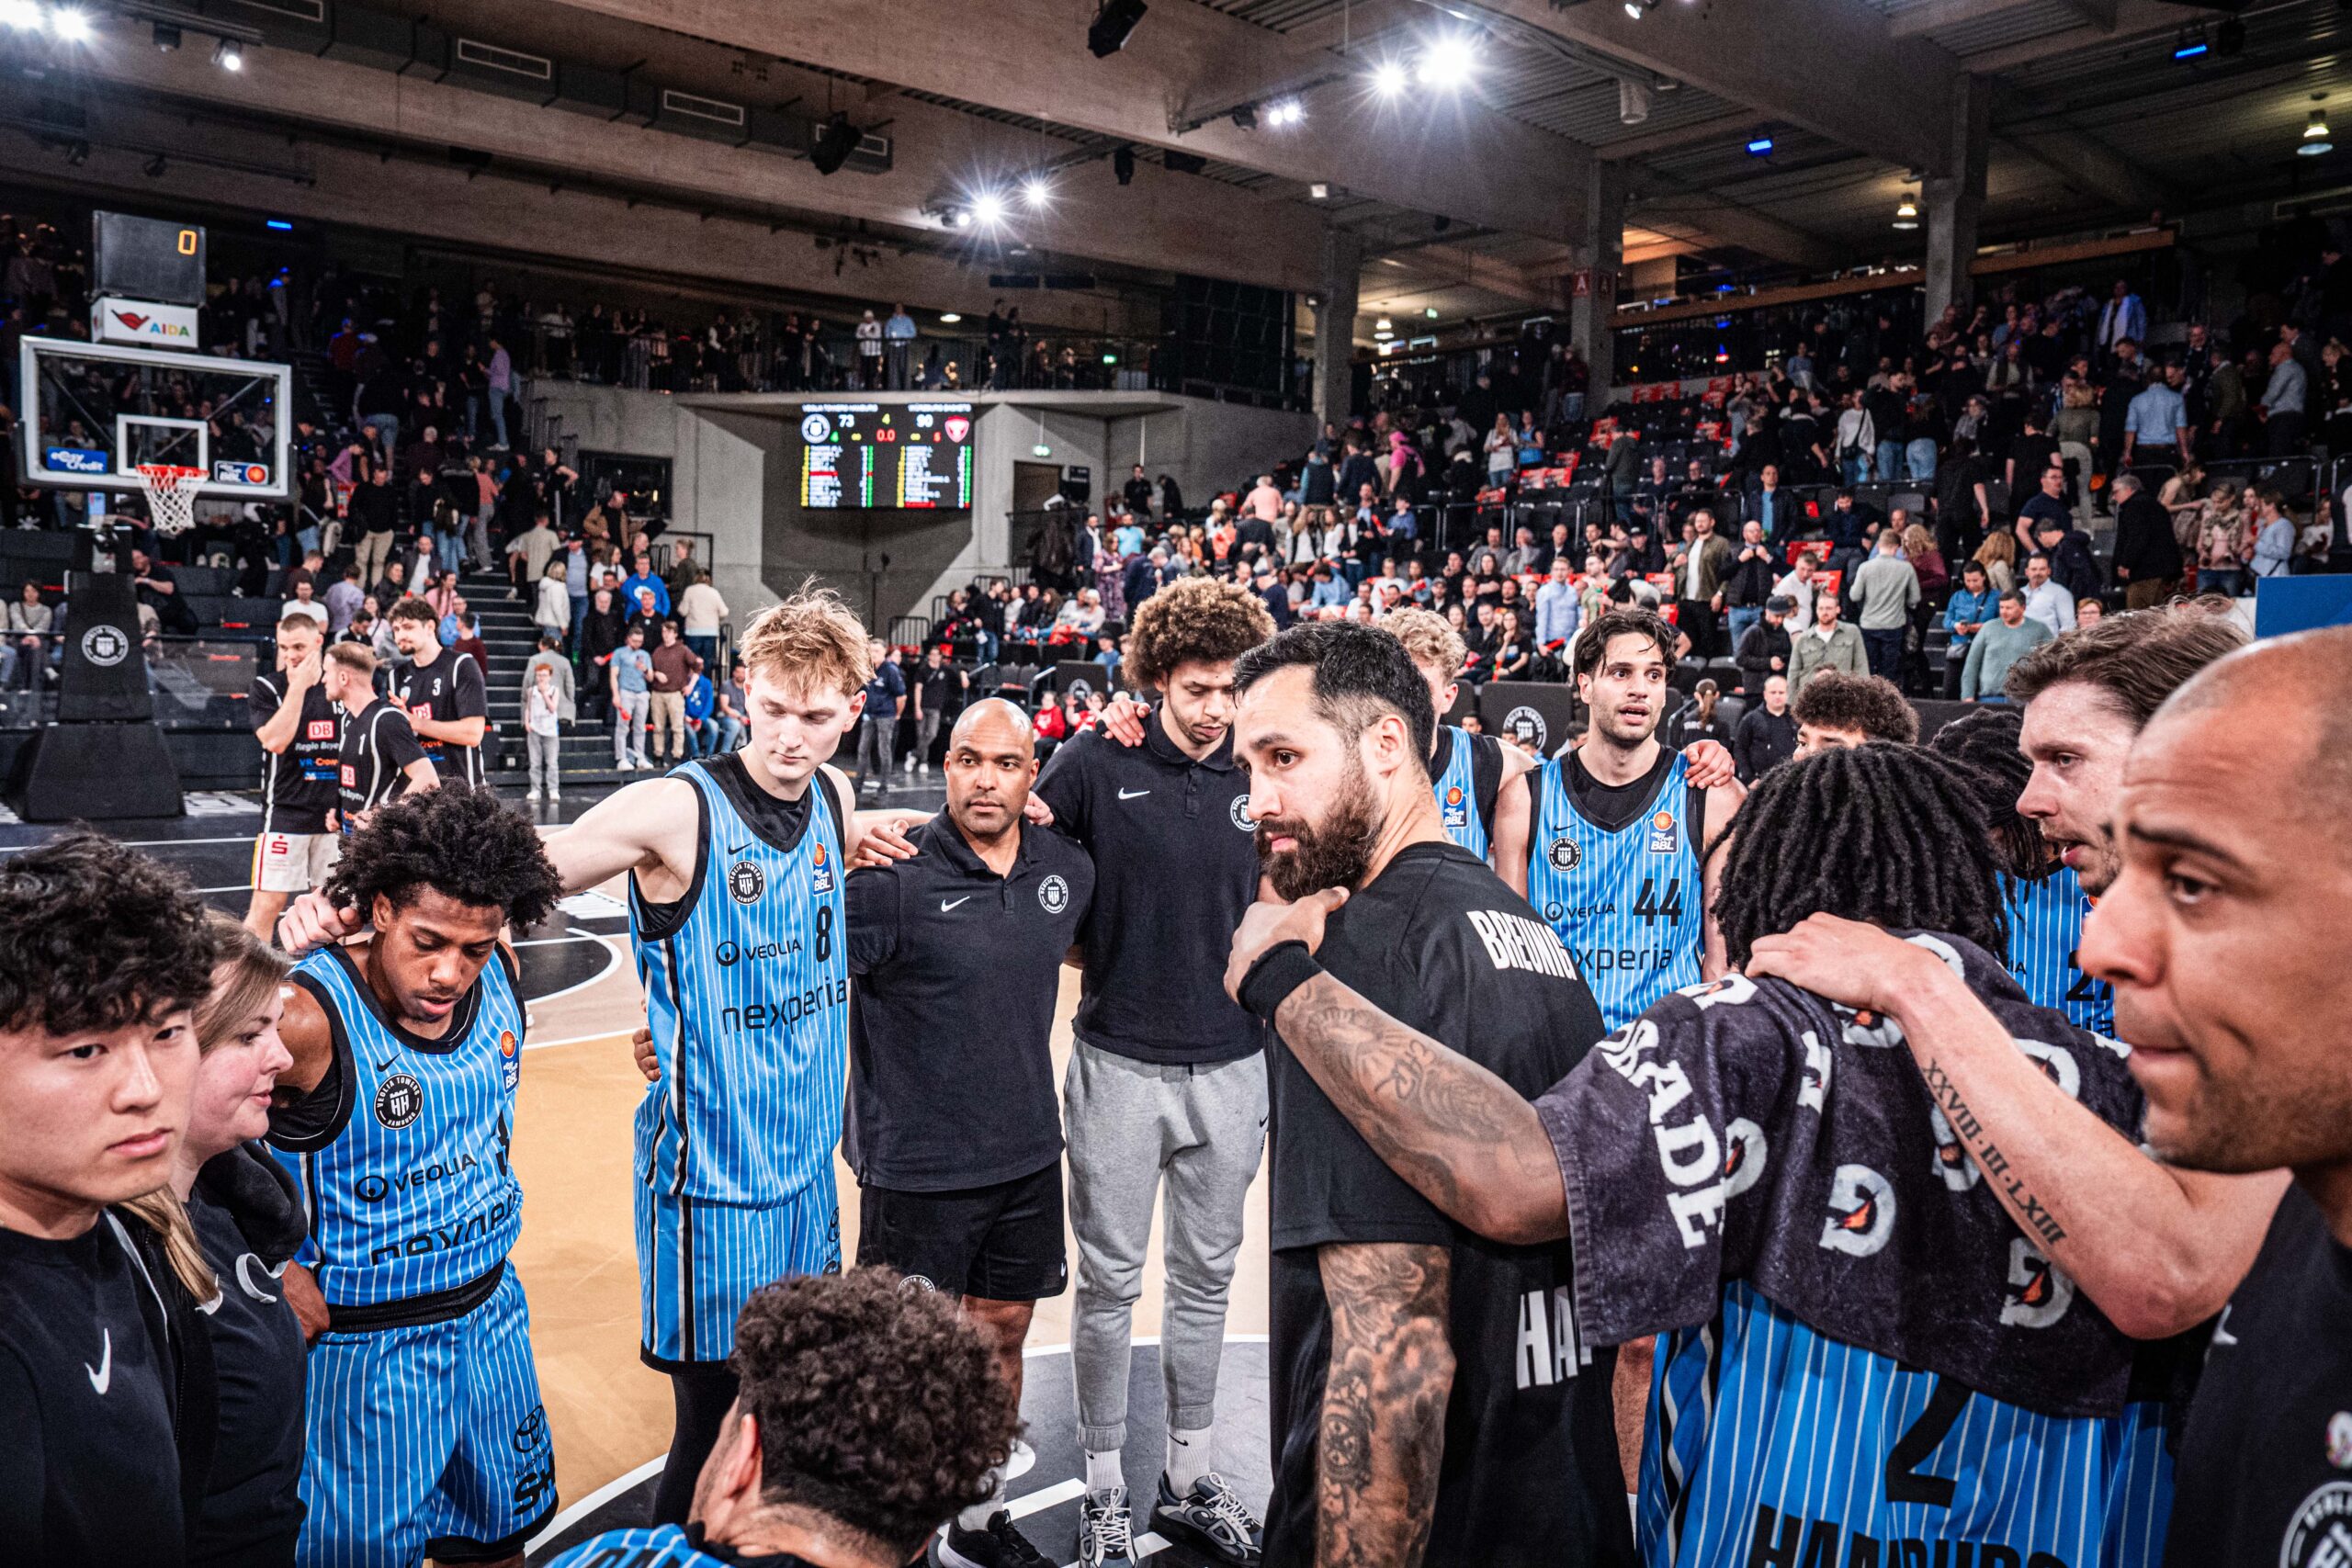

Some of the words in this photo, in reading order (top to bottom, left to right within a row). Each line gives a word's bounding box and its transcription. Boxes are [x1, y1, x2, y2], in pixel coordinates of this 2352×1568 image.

[177, 230, 197, 255] 0
[150, 321, 190, 337] AIDA
[876, 428, 896, 443] 0.0
[432, 678, 441, 696] 3
[312, 724, 331, 736] DB
[1444, 816, 1464, 826] BBL
[1650, 840, 1674, 851] BBL
[814, 877, 831, 891] BBL
[1632, 878, 1682, 927] 44
[815, 905, 831, 963] 8
[1466, 909, 1578, 981] BREUNIG
[744, 938, 802, 961] VEOLIA
[1566, 943, 1673, 980] xperia
[722, 976, 848, 1034] nexperia
[377, 1079, 395, 1108] VEOLIA
[396, 1077, 421, 1096] TOWERS
[393, 1153, 478, 1192] VEOLIA
[1516, 1284, 1593, 1390] HA
